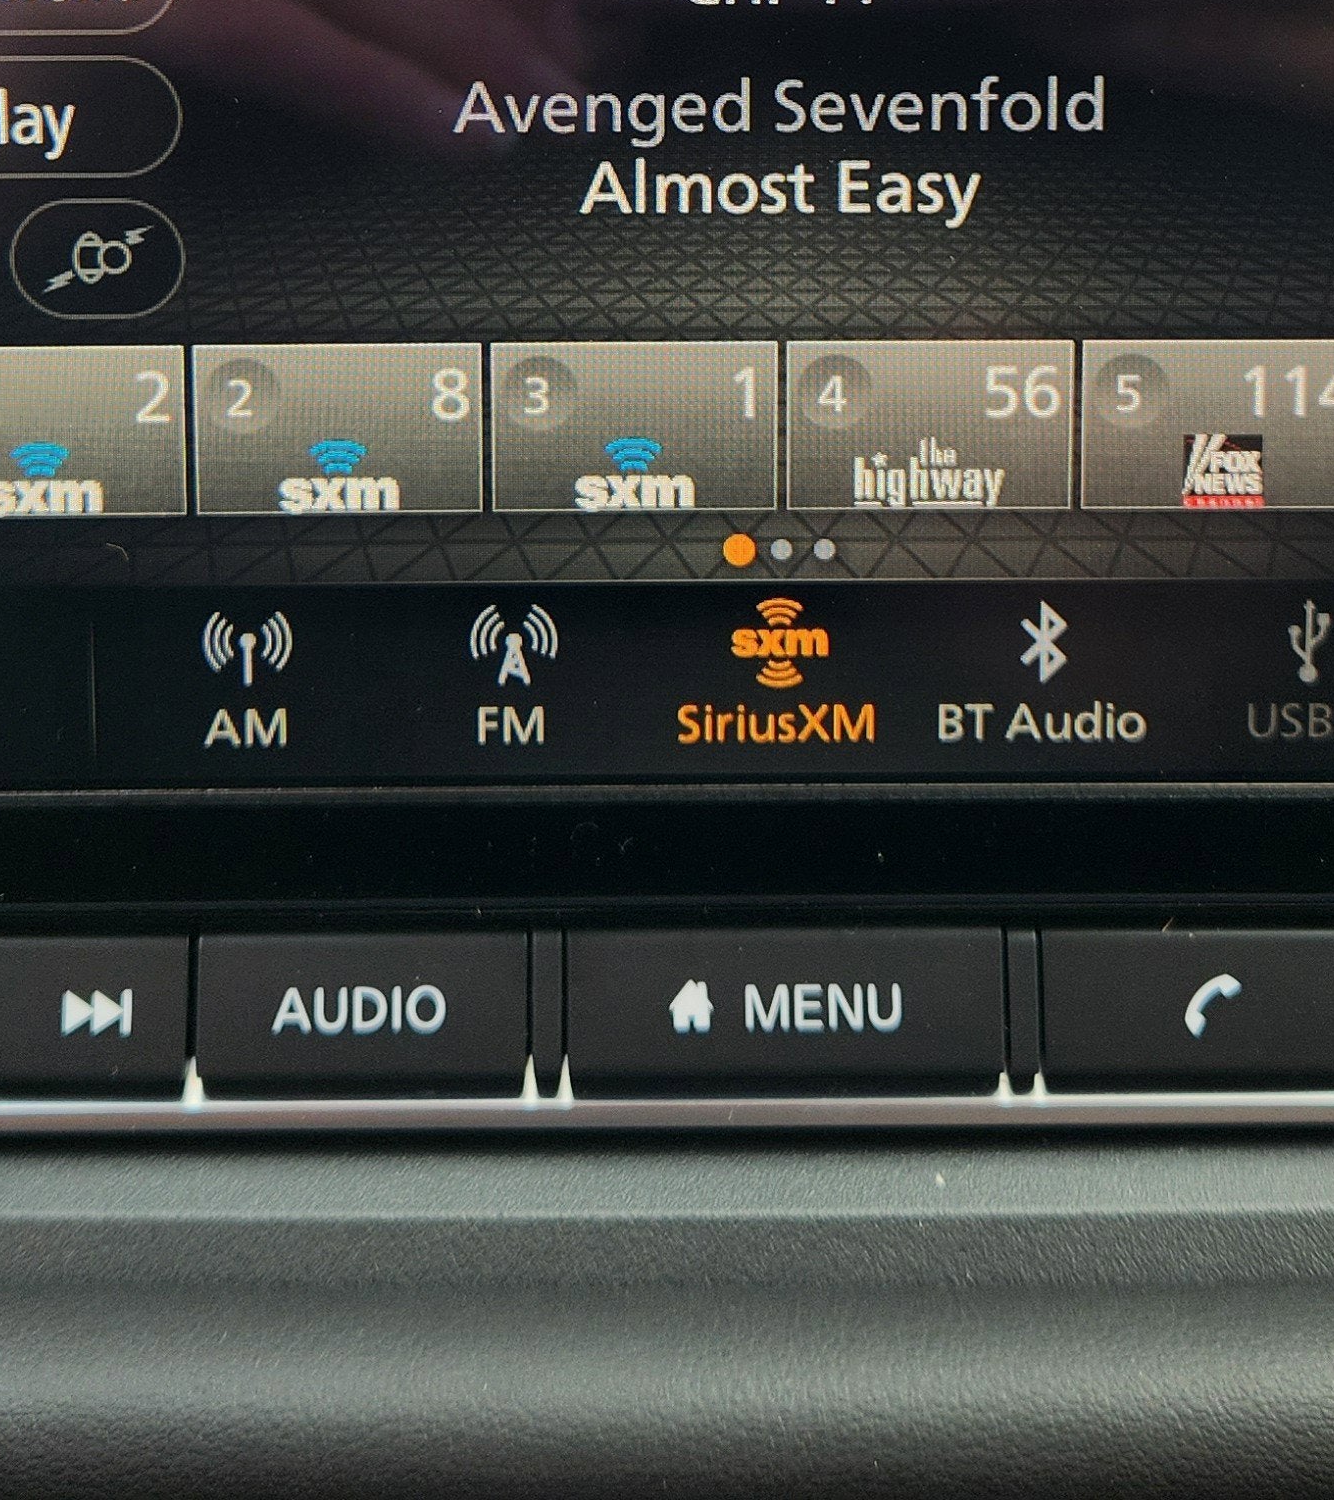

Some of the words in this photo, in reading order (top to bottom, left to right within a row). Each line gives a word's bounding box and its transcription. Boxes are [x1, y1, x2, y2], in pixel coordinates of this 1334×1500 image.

[453, 76, 751, 147] Avenged
[774, 75, 1105, 132] Sevenfold
[579, 157, 815, 215] Almost
[838, 159, 981, 228] Easy
[134, 372, 171, 423] 2
[226, 379, 253, 418] 2
[432, 368, 471, 422] 8
[524, 377, 551, 415] 3
[732, 368, 758, 418] 1
[817, 374, 848, 412] 4
[984, 366, 1061, 418] 56
[1115, 374, 1142, 412] 5
[853, 453, 1006, 507] highway
[1210, 451, 1262, 473] FOX
[278, 476, 399, 512] sxm
[575, 471, 694, 509] sxm
[1194, 473, 1263, 494] NEWS
[731, 628, 829, 658] sxm
[205, 708, 288, 747] AM
[477, 706, 546, 745] FM
[677, 703, 875, 744] SiriusXM
[937, 704, 993, 742] BT
[1005, 702, 1147, 743] Audio
[271, 984, 447, 1034] AUDIO
[744, 983, 904, 1032] MENU
